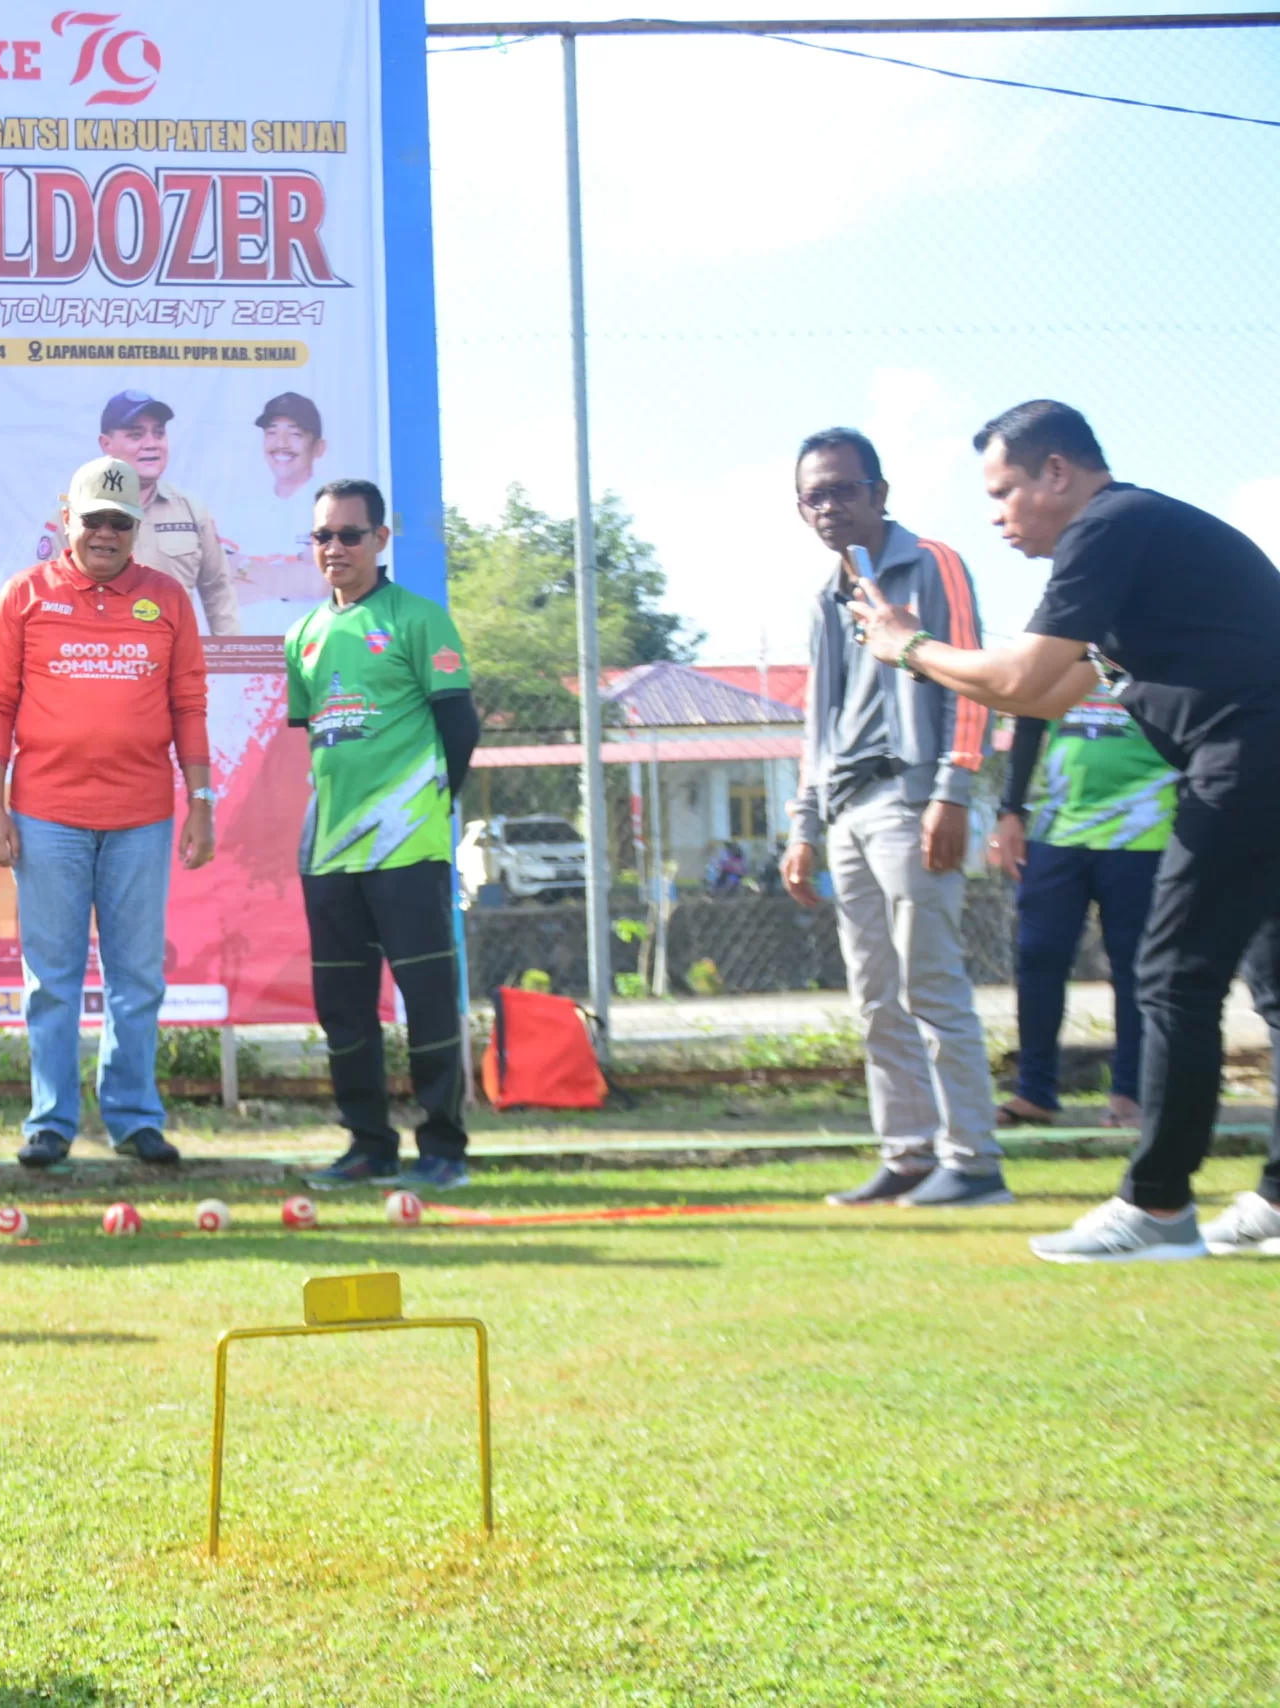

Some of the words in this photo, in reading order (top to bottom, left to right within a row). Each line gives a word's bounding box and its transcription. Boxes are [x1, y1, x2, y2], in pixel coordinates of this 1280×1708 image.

[51, 10, 161, 107] 79
[75, 118, 246, 152] KABUPATEN
[253, 119, 347, 154] SINJAI
[232, 300, 325, 326] 2024
[46, 345, 115, 360] LAPANGAN
[117, 346, 181, 361] GATEBALL
[183, 346, 219, 361] PUPR
[221, 347, 252, 361] KAB.
[254, 347, 297, 362] SINJAI
[60, 643, 109, 658] GOOD
[112, 643, 149, 658] JOB
[48, 660, 159, 677] COMMUNITY
